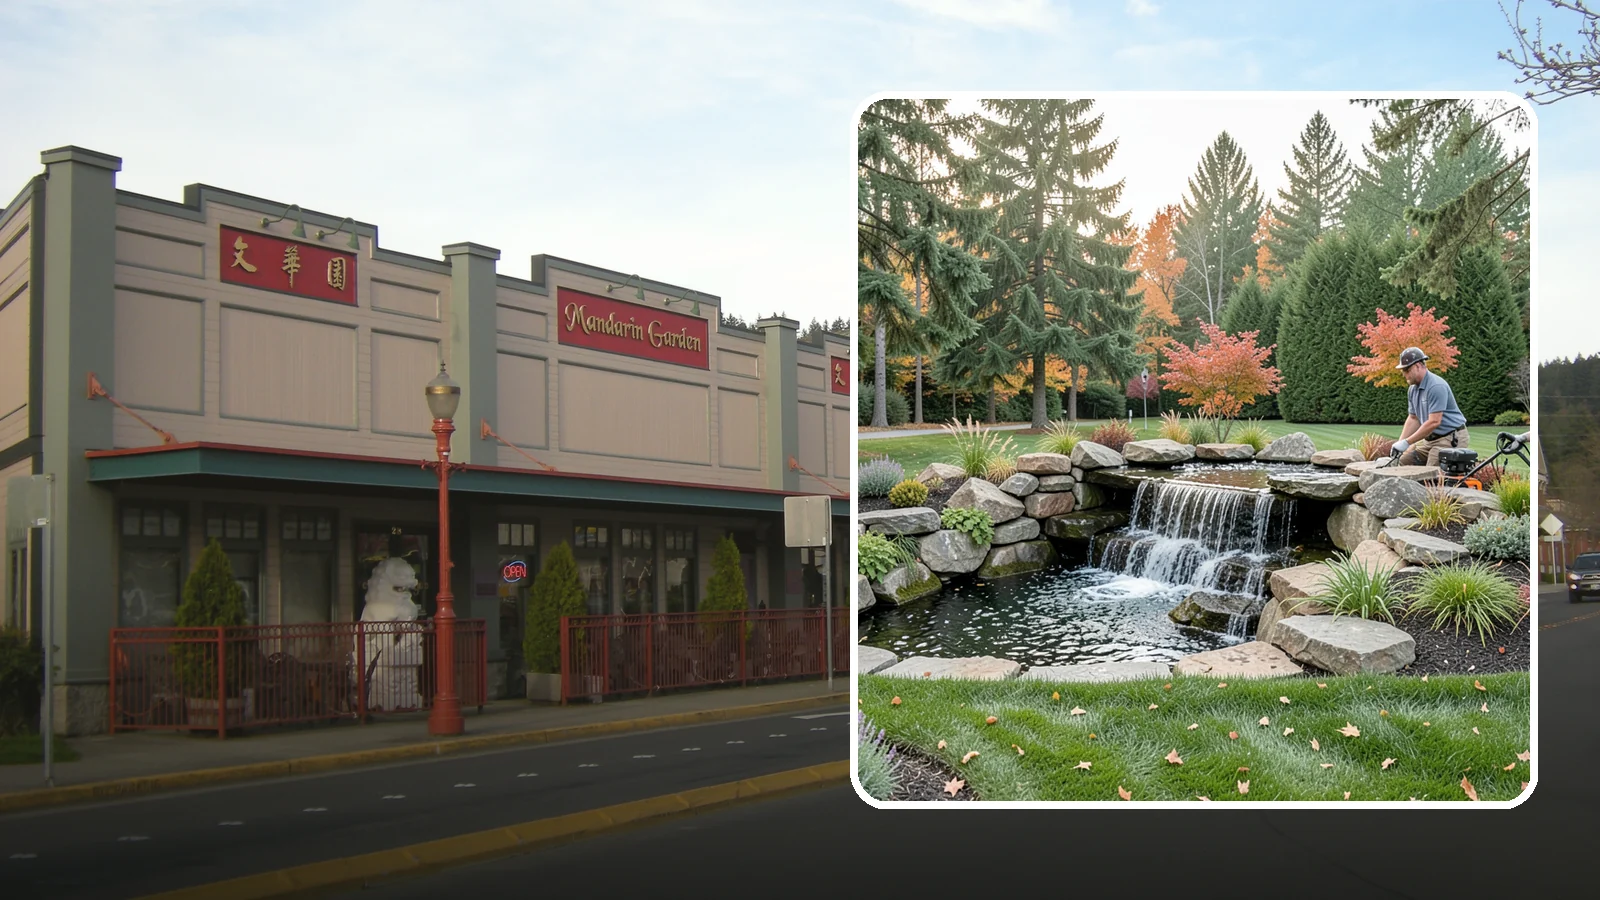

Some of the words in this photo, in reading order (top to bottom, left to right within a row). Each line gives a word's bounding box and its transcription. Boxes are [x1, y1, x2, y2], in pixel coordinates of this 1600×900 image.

[231, 236, 346, 290] 文華園
[564, 302, 643, 341] Mandarin
[648, 320, 701, 352] Garden
[503, 565, 527, 578] OPEN
